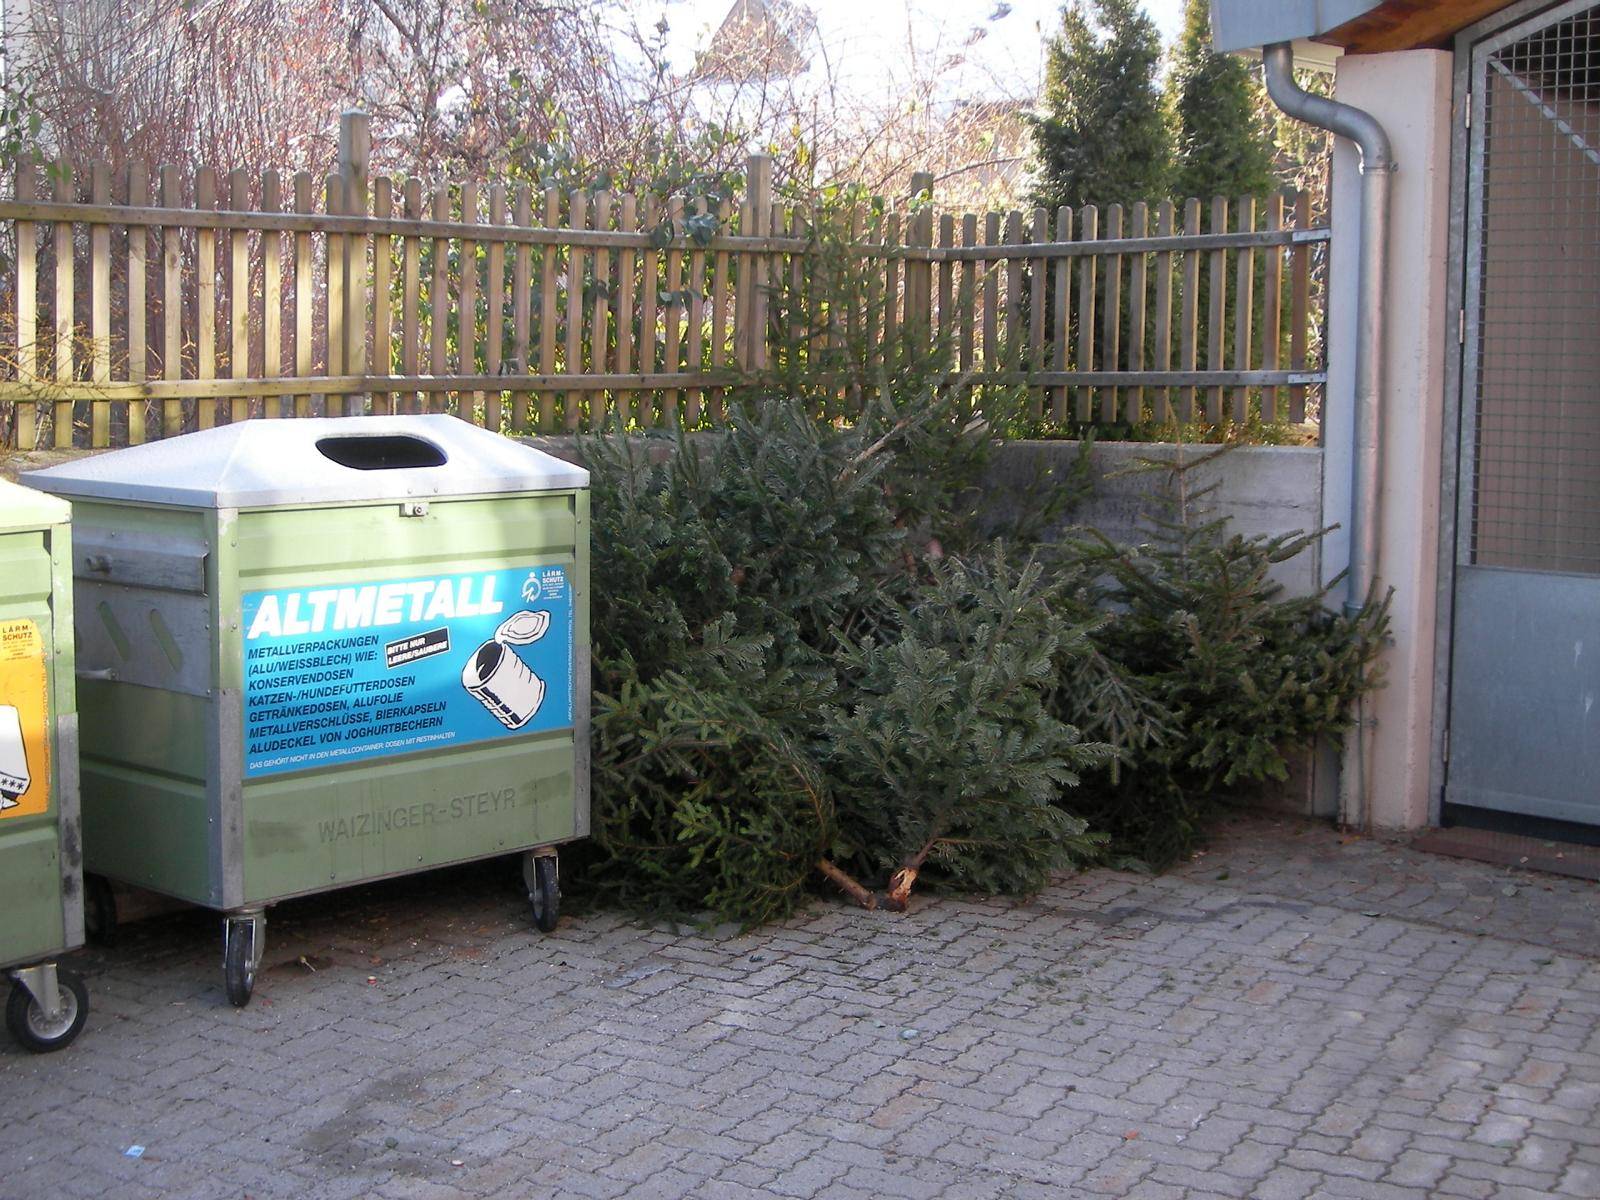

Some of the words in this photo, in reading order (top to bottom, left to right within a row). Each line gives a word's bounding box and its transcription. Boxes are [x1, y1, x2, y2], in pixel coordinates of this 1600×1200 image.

[247, 575, 503, 639] ALTMETALL
[2, 632, 32, 641] SCHUTZ
[248, 635, 379, 659] METALLVERPACKUNGEN
[387, 642, 409, 655] BITTE
[409, 637, 426, 649] NUR
[248, 654, 352, 677] (ALU/WEISSBLECH)
[355, 651, 378, 662] WIE:
[248, 669, 354, 691] KONSERVENDOSEN
[248, 676, 416, 707] KATZEN-/HUNDEFUTTERDOSEN
[249, 712, 373, 739] METALLVERSCHLÜSSE,
[375, 701, 447, 721] BIERKAPSELN
[250, 700, 350, 722] GETRÄNKEDOSEN,
[353, 692, 404, 709] ALUFOLIE
[249, 735, 316, 754] ALUDECKEL
[320, 731, 342, 744] VON
[344, 717, 443, 740] JOGHURTBECHERN
[249, 761, 263, 770] DAS
[289, 753, 309, 763] NICHT
[309, 752, 316, 760] IN
[316, 750, 329, 759] DEN
[385, 739, 405, 748] DOSEN
[404, 737, 416, 745] MIT
[415, 731, 455, 744] RESTINHALTEN
[317, 787, 516, 843] WAIZINGER-STEYR
